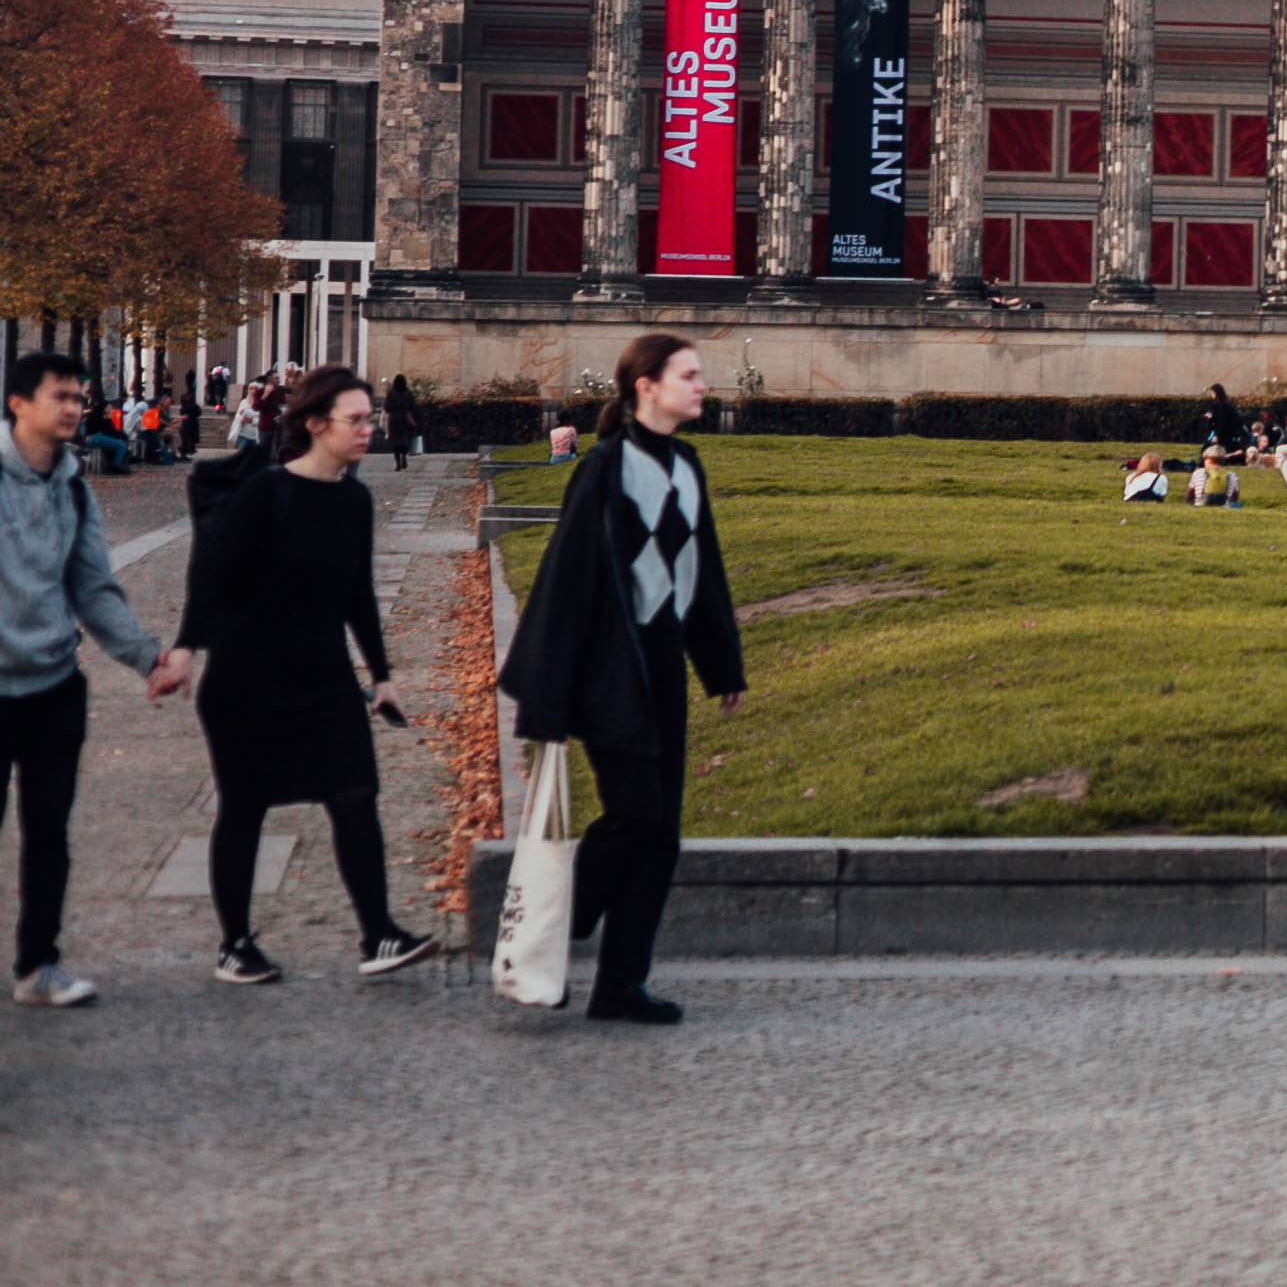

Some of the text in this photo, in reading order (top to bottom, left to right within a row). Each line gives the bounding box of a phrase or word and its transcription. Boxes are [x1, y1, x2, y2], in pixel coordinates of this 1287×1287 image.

[664, 50, 699, 169] ALTES
[870, 57, 904, 204] ANTIKE
[832, 234, 866, 245] ALTES
[832, 246, 883, 257] MUSEUM
